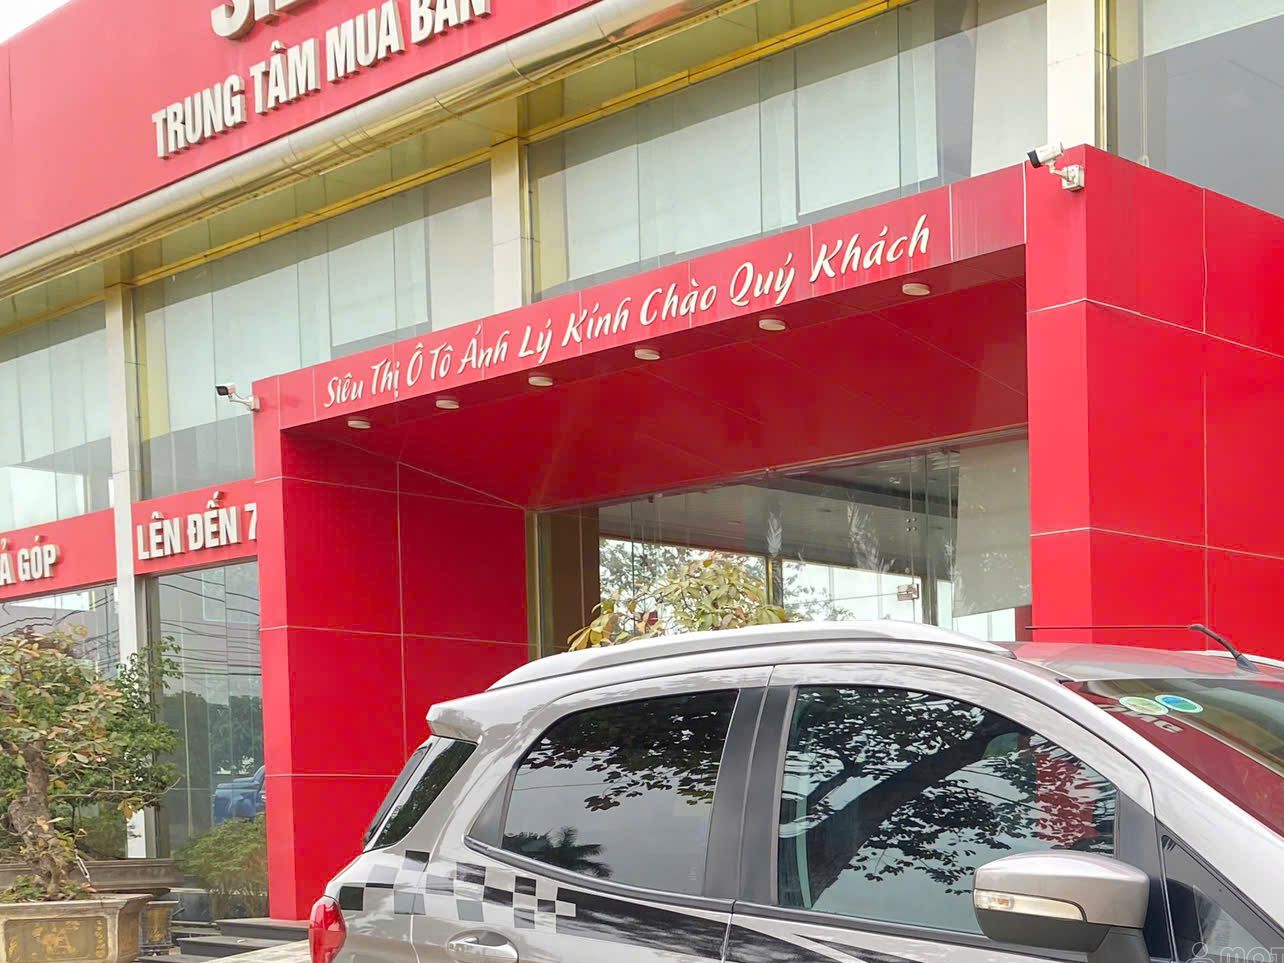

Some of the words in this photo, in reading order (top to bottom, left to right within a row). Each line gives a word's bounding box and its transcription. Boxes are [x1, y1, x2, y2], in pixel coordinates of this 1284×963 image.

[152, 74, 246, 158] TRUNG
[249, 38, 320, 114] TÂM
[324, 0, 405, 82] MUA
[323, 371, 364, 409] Siêu
[371, 358, 400, 400] Thị
[406, 343, 424, 387] Ô
[430, 344, 454, 381] Tô
[457, 324, 510, 374] Ánh
[518, 318, 552, 364] Lý
[562, 297, 632, 347] Kính
[639, 278, 717, 326] Chào
[729, 252, 796, 307] Quý
[808, 213, 931, 283] Khách
[17, 535, 60, 582] GÓP
[136, 511, 185, 560] LÊN
[187, 491, 242, 551] ĐẾN
